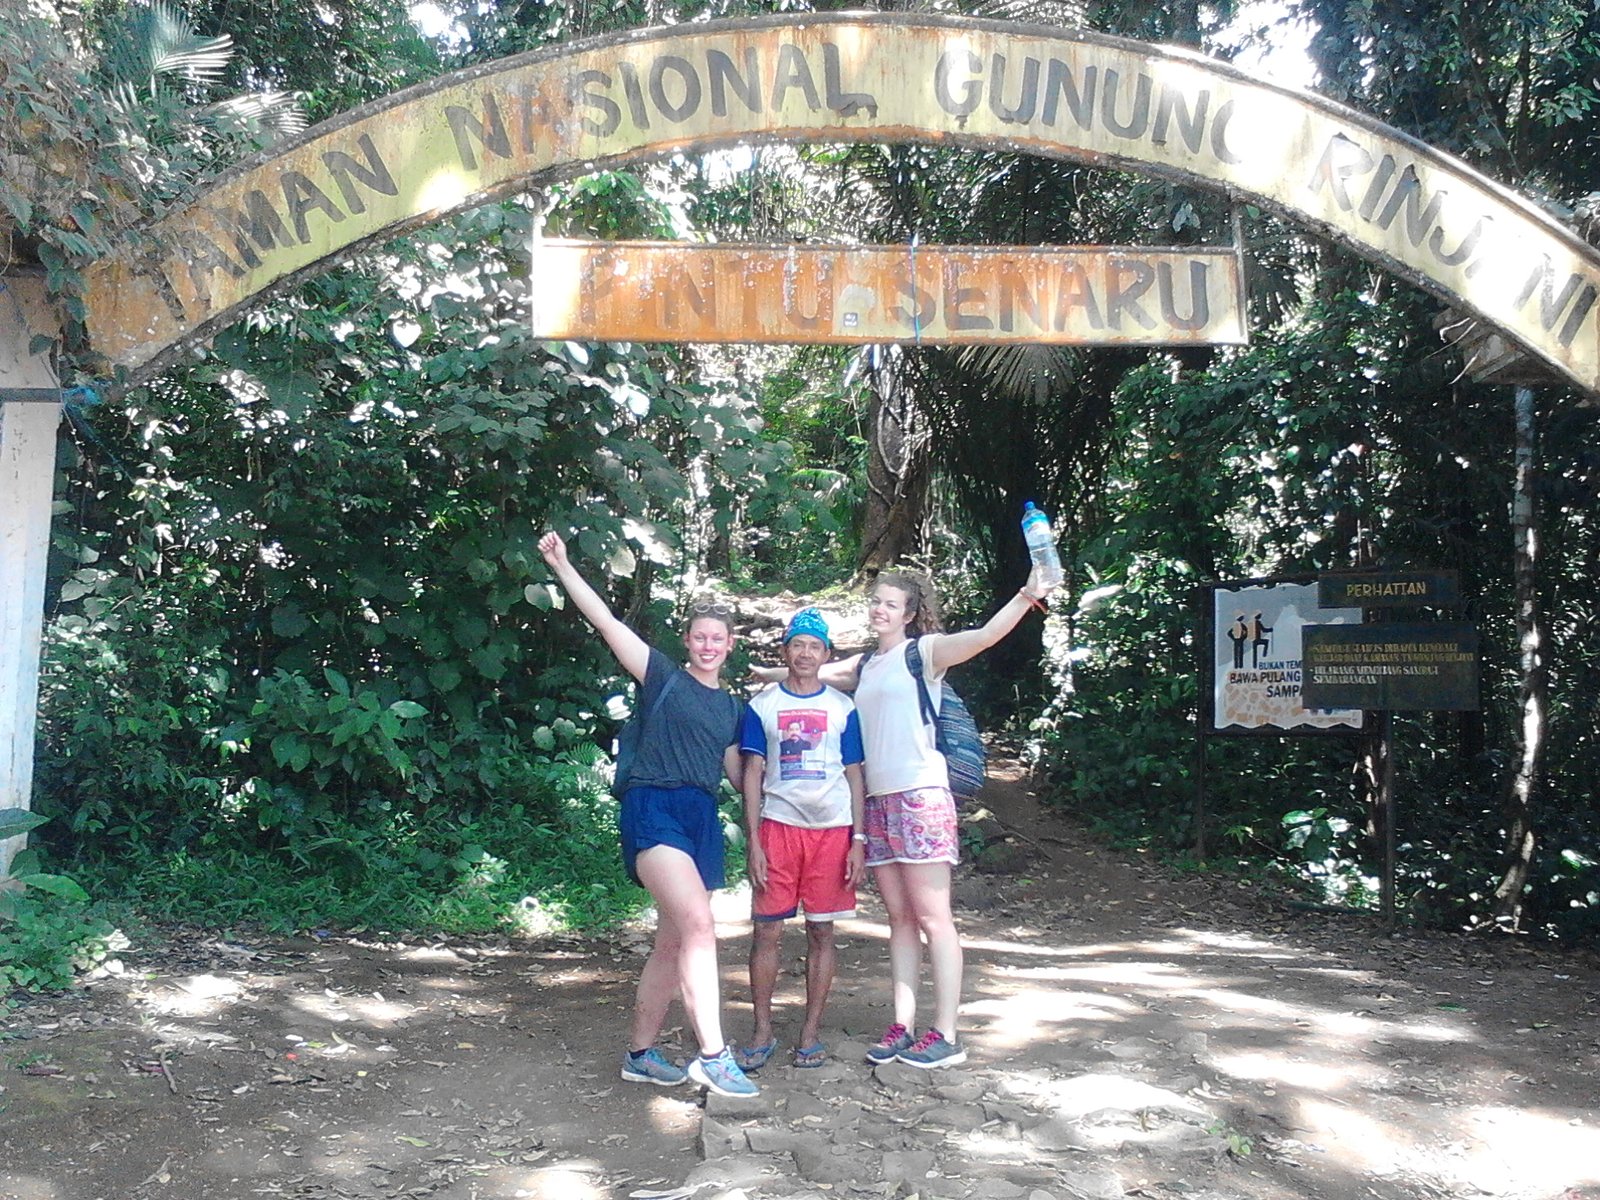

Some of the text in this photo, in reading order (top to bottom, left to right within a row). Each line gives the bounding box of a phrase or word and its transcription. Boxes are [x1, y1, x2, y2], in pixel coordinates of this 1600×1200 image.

[1308, 132, 1598, 348] RINJNI
[580, 250, 1211, 332] PNTU SENARU
[1230, 671, 1301, 684] BAWA PULANG
[1259, 661, 1284, 670] BUKAN
